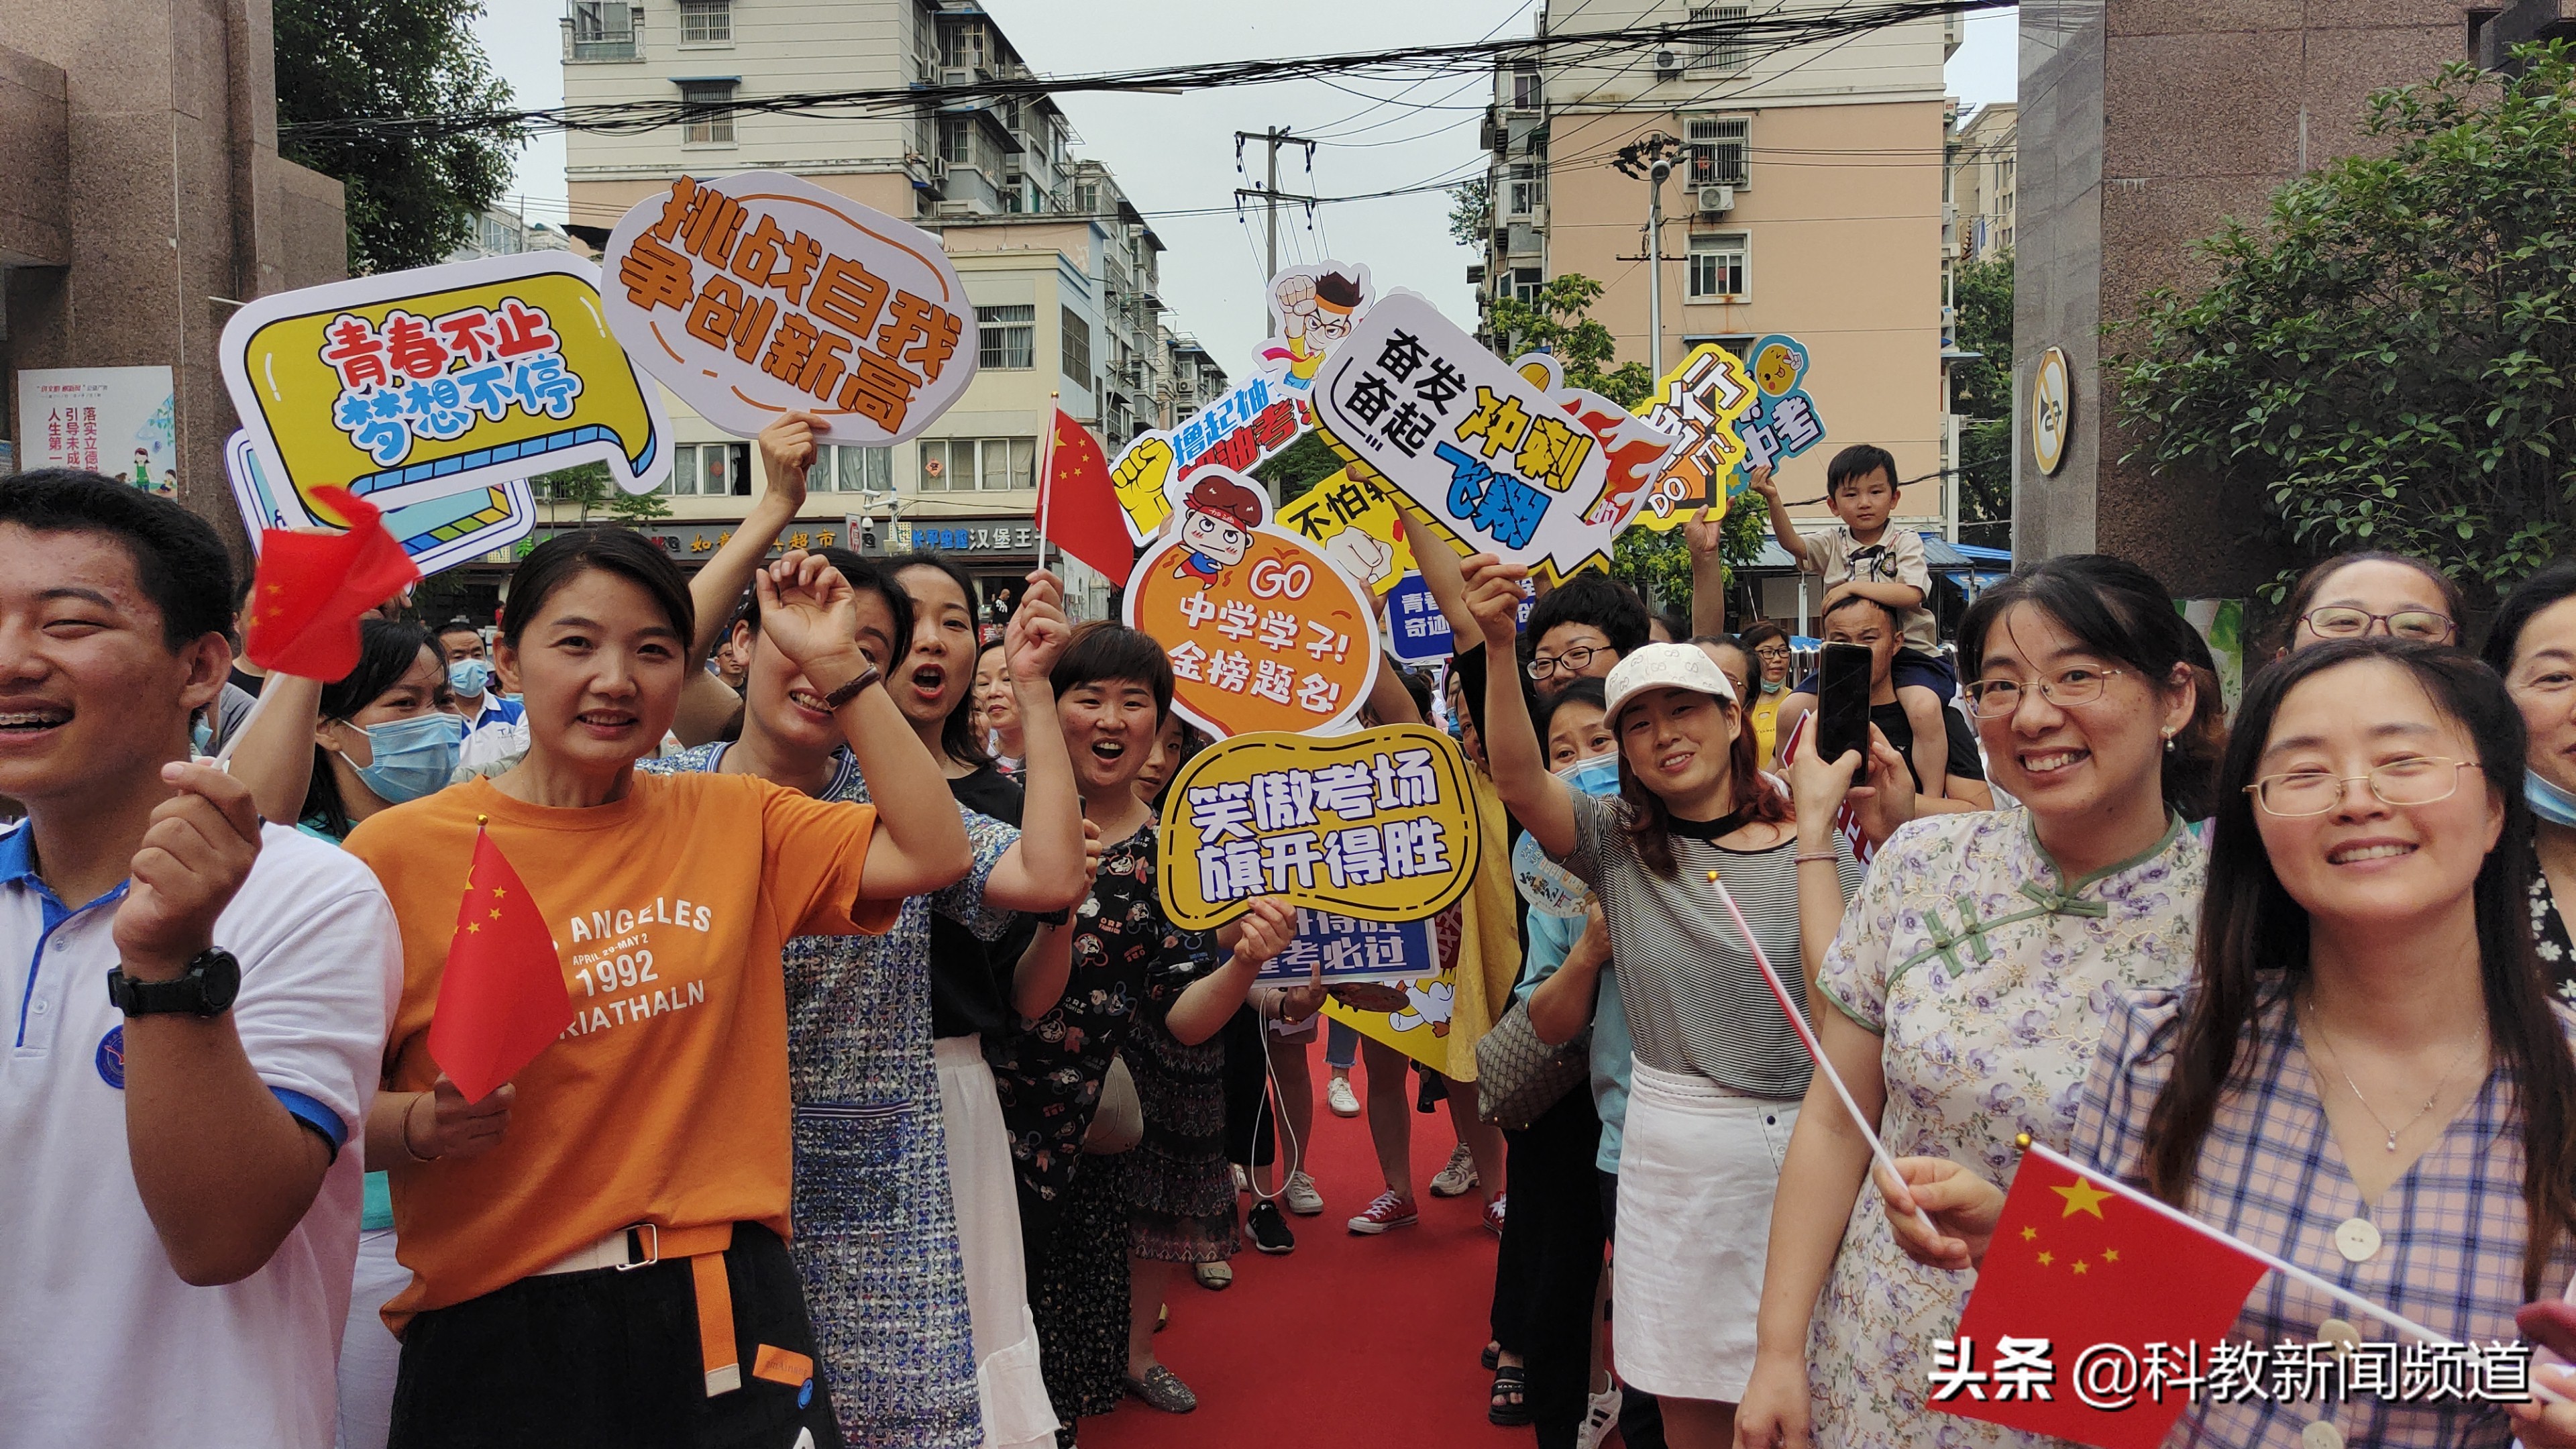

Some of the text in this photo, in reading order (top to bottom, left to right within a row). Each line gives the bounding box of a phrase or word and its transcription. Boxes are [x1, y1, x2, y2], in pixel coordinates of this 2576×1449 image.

[653, 174, 963, 380] 挑战自我
[325, 301, 556, 389] 青春不止
[619, 232, 923, 435] 争创新高
[1375, 327, 1467, 416] 奋发
[48, 407, 63, 461] 人生第一
[65, 407, 81, 470] 引导未成
[341, 352, 578, 462] 梦想不停
[1173, 377, 1281, 468] 撸起袖
[1344, 370, 1437, 458] 奋起
[1454, 385, 1595, 492] 冲刺
[1739, 394, 1823, 474] 中考
[1433, 440, 1553, 551] 飞翔
[1648, 477, 1693, 519] DO
[1689, 433, 1737, 477] IT!
[1248, 556, 1314, 602] GO
[1179, 590, 1352, 663] 中学学子!
[1167, 639, 1342, 713] 金榜题名!
[1187, 747, 1438, 844] 笑傲考场
[1194, 816, 1453, 903] 旗开得胜
[571, 897, 712, 943] ANGELES
[573, 953, 602, 966] APRIL
[641, 932, 649, 944] 2
[575, 949, 659, 997] 1992
